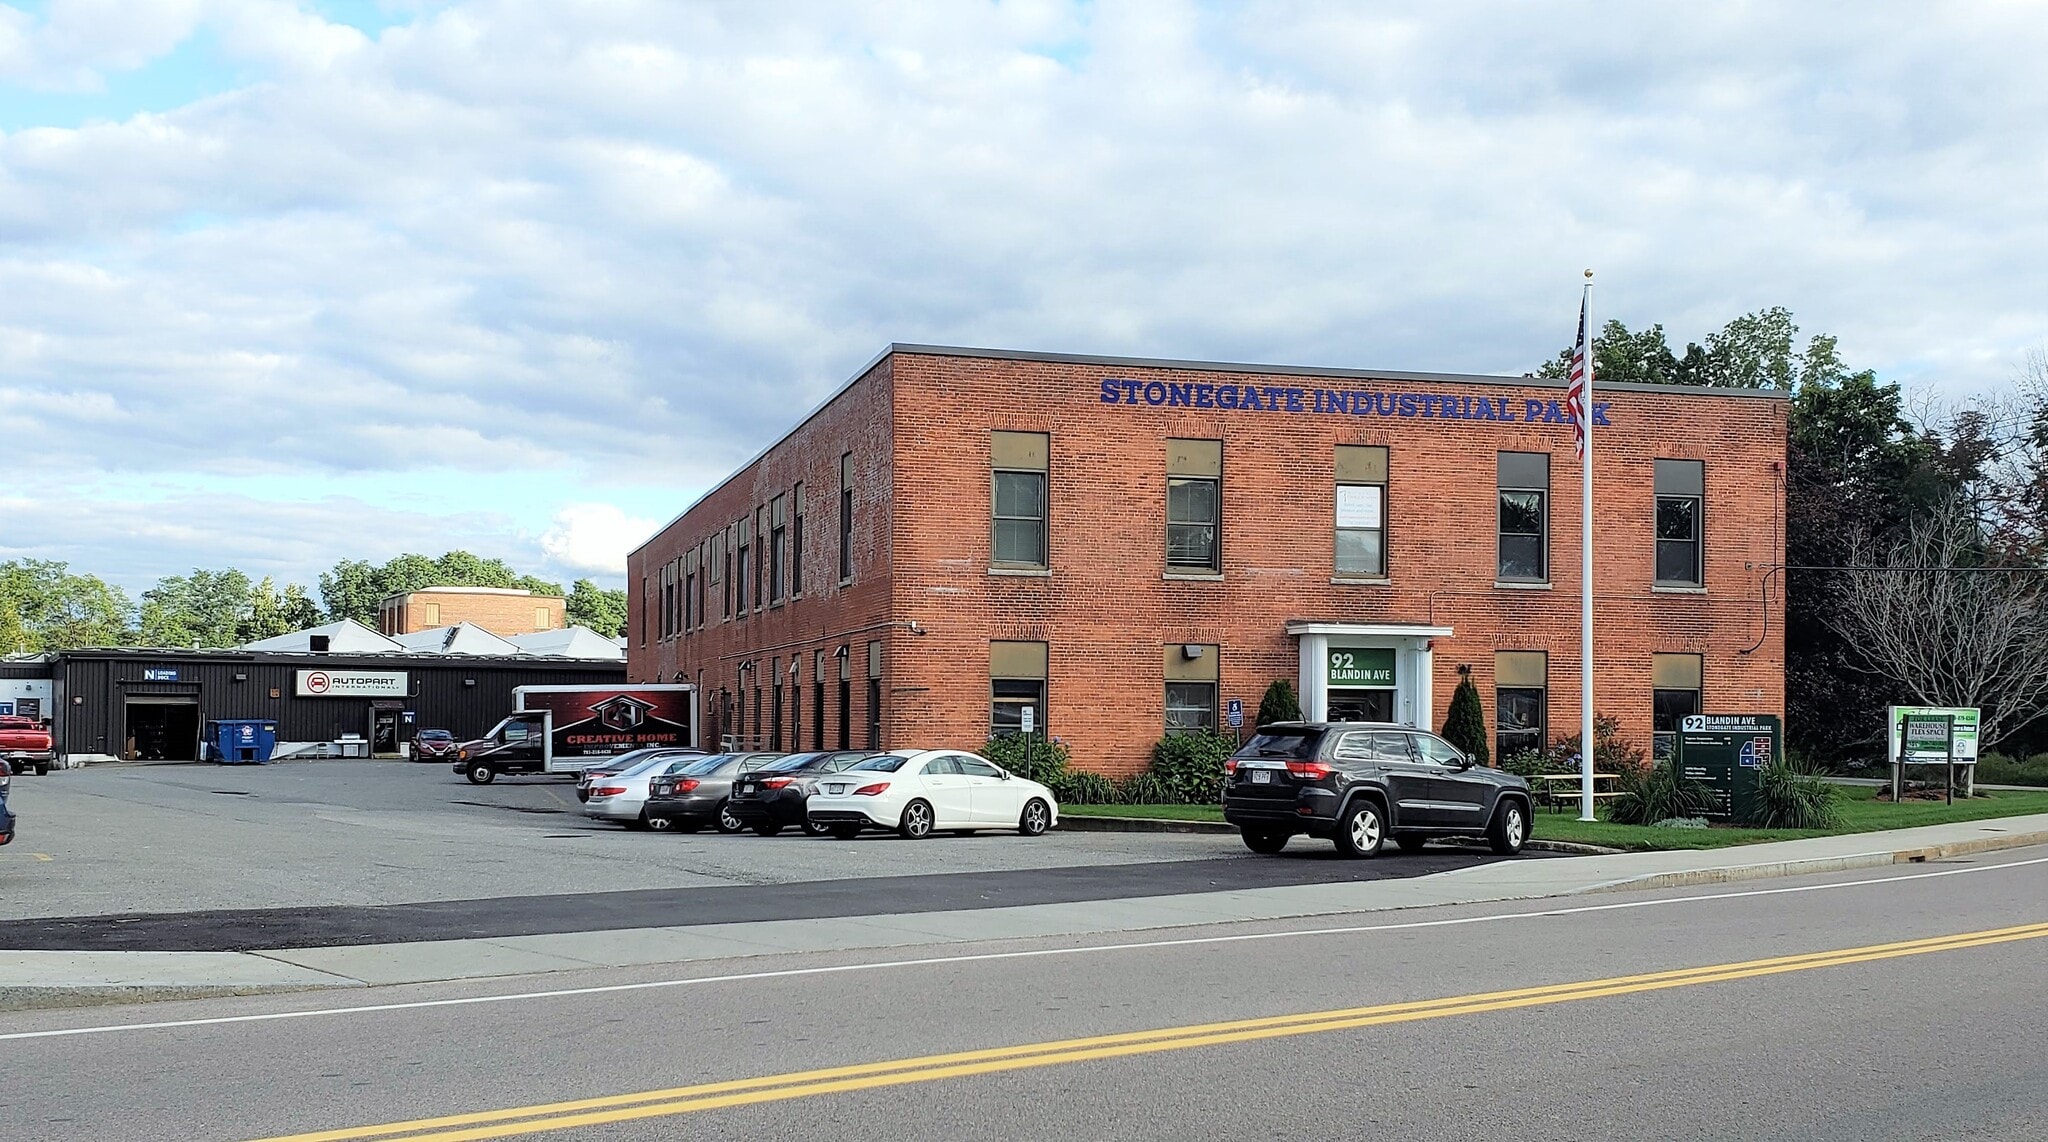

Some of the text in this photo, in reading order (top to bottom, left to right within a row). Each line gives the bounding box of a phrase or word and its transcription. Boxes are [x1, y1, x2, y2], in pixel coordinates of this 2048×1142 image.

[1100, 379, 1611, 425] STONEGATE INDUSTRIAL PAK
[1331, 653, 1354, 669] 92
[144, 669, 154, 680] N
[1331, 669, 1390, 680] BLANDIN AVE
[332, 677, 396, 685] AUTOPART
[404, 715, 412, 723] N
[1685, 716, 1756, 729] 92 BLANDIN AVE
[566, 733, 677, 744] CREATIVE HOME
